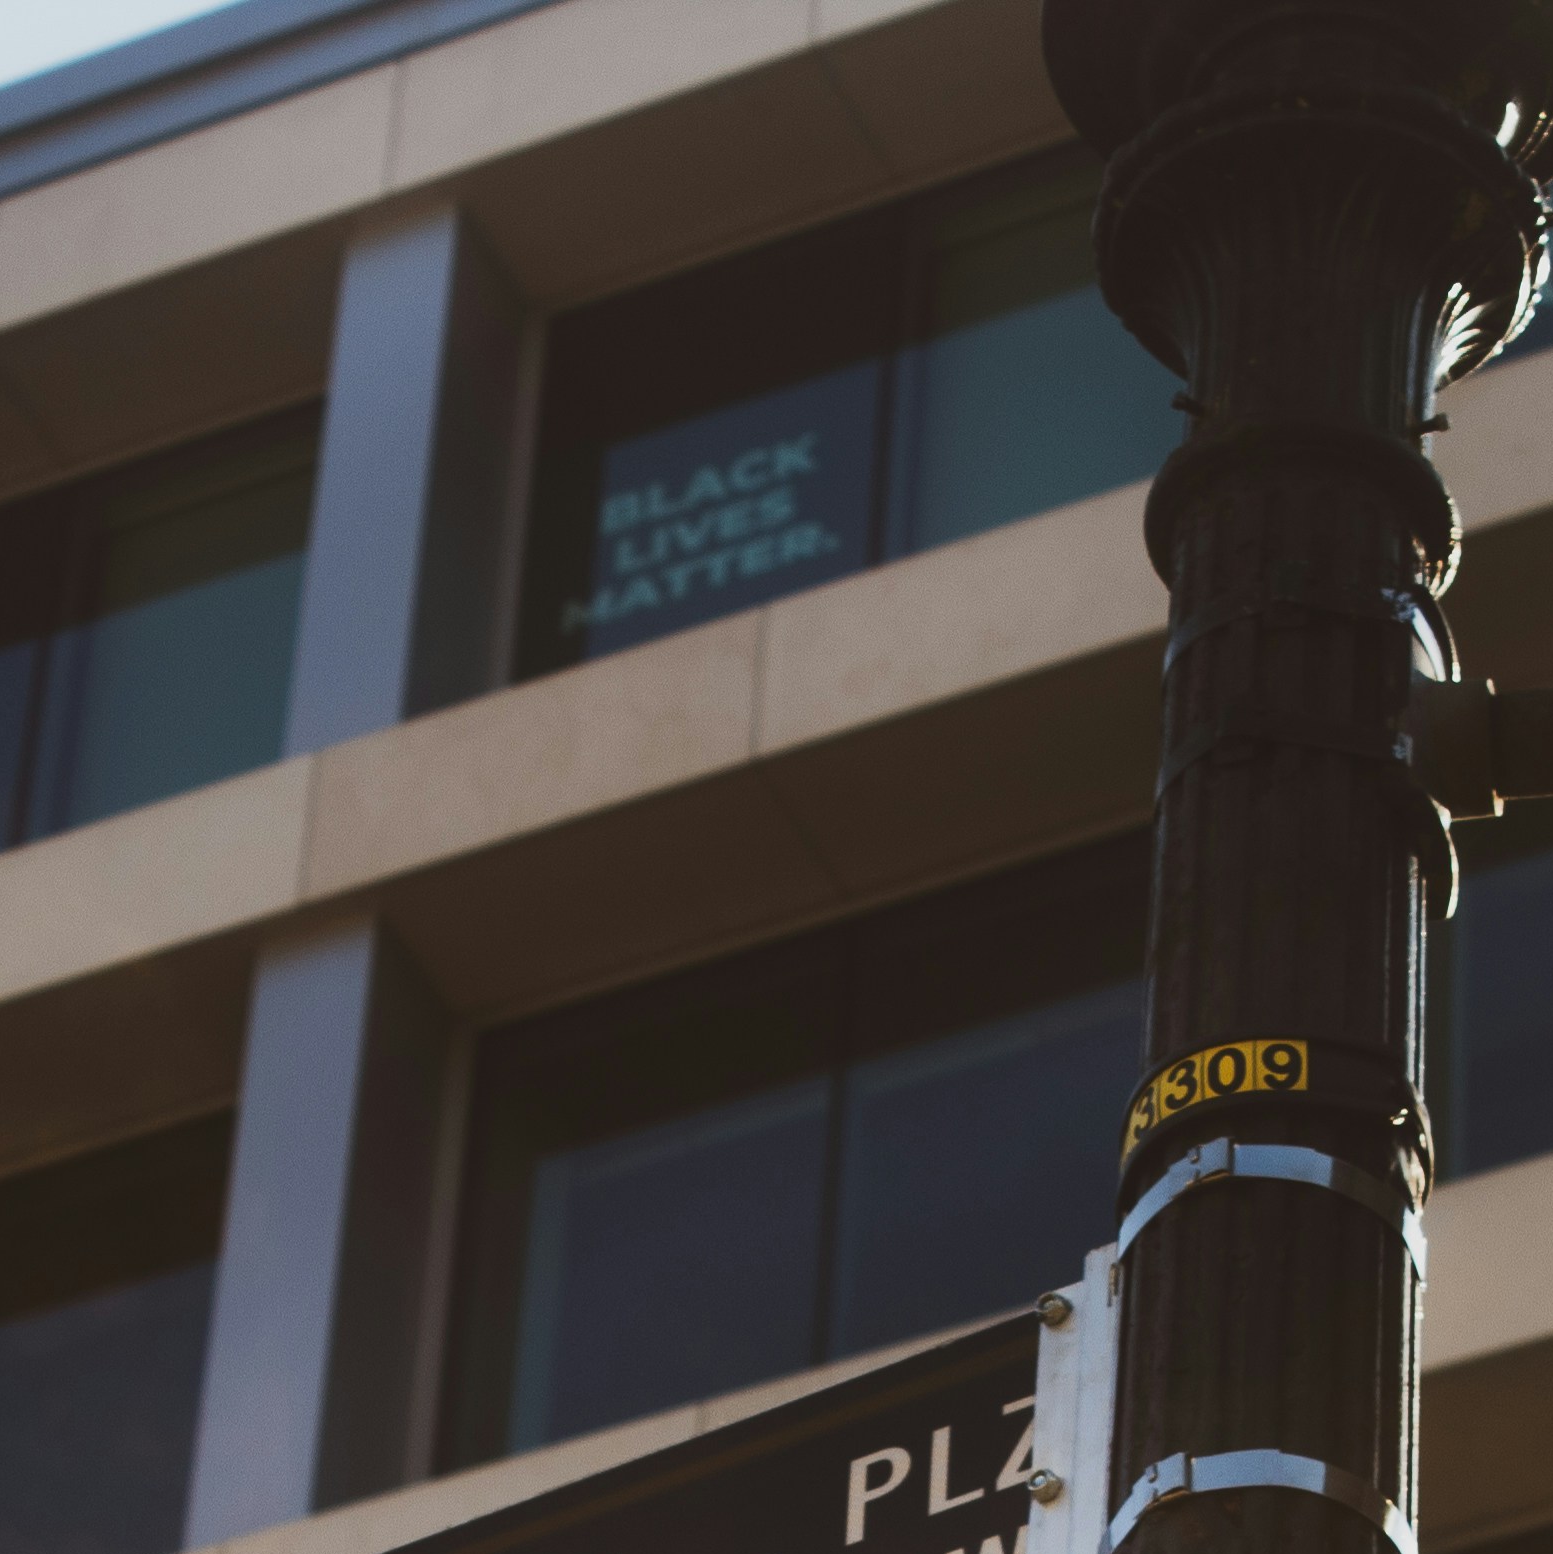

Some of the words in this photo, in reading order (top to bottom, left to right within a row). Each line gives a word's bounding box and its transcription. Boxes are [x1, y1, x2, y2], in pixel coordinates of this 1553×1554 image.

[600, 431, 818, 535] BLACK
[613, 487, 794, 575] LIVES
[559, 519, 841, 635] MATTER.
[1132, 1043, 1303, 1141] 3309
[844, 1394, 1036, 1546] PLZ
